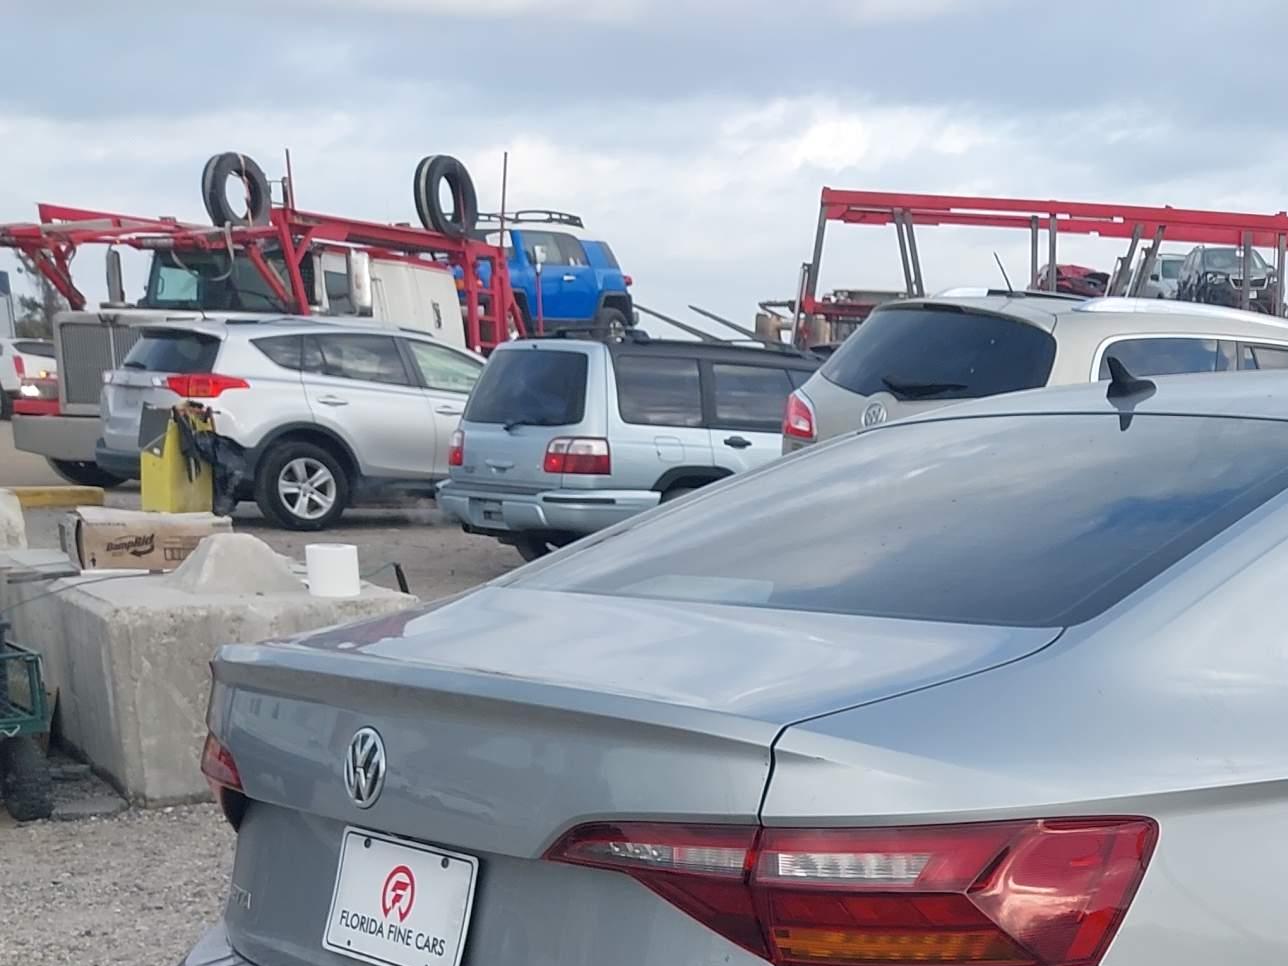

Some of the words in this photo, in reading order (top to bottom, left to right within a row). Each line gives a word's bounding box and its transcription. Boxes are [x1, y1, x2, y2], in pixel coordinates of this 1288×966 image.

[339, 909, 385, 939] FLORIDA
[387, 923, 413, 947] FINE
[415, 932, 446, 957] CARS
